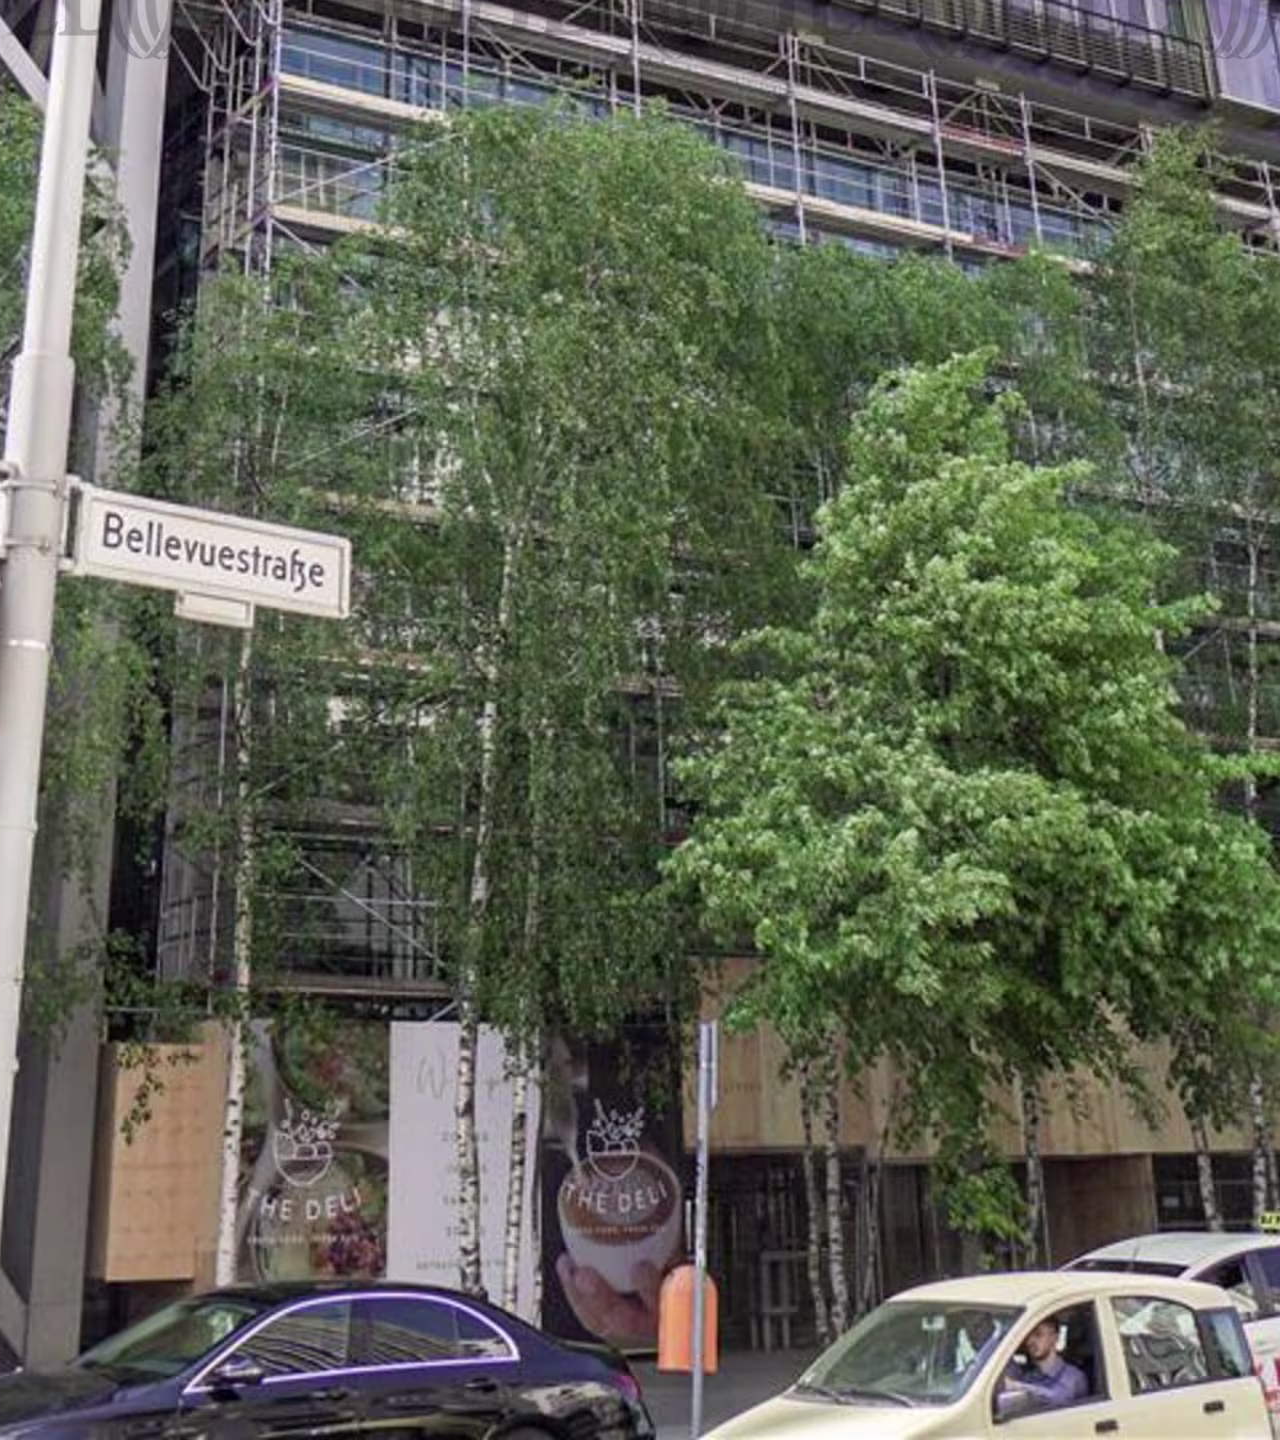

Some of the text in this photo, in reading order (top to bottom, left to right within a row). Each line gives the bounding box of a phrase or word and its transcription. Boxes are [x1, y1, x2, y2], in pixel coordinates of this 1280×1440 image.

[102, 513, 325, 594] Bellevuestraße
[247, 1186, 362, 1221] THE DELI
[562, 1180, 668, 1215] THE DELI
